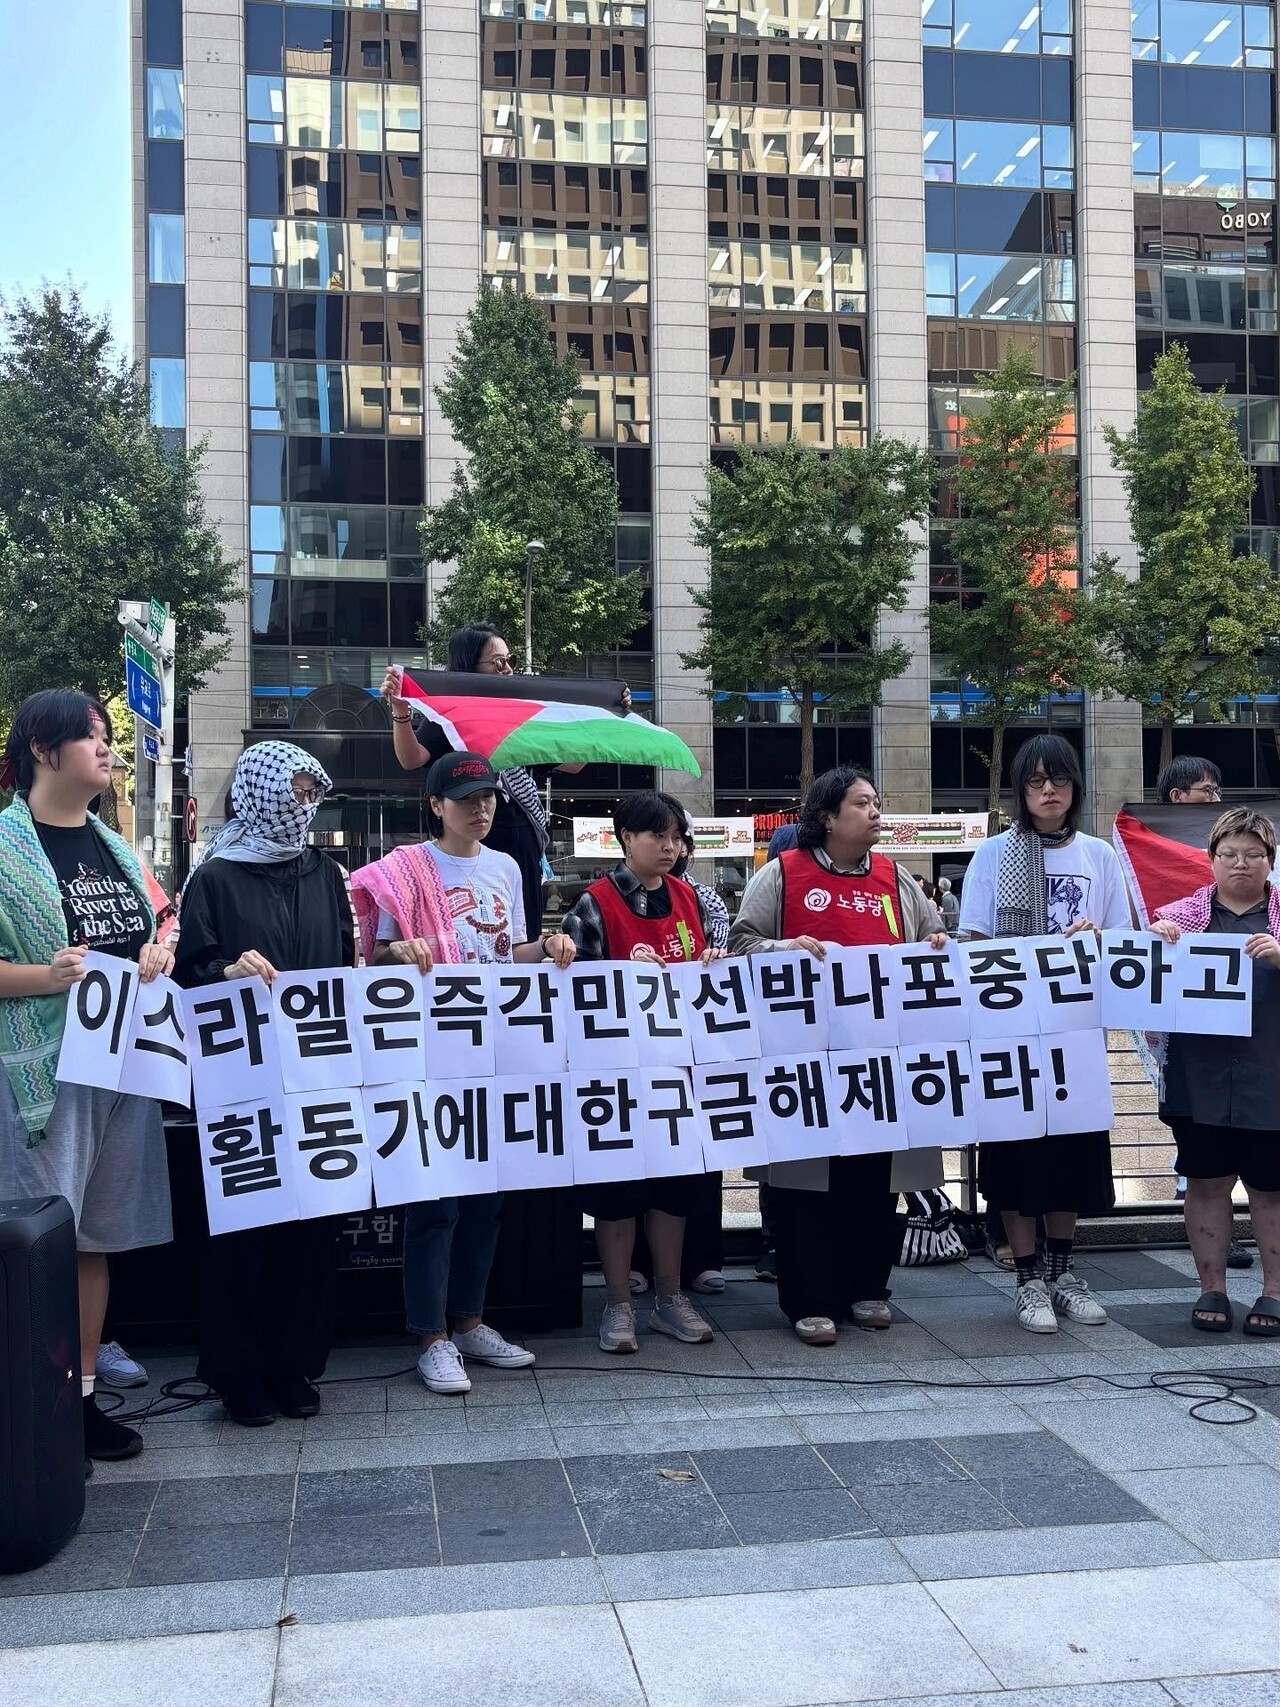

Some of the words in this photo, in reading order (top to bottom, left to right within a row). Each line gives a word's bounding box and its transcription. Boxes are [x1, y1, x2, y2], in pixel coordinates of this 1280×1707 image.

[101, 875, 129, 893] the
[65, 896, 120, 916] River
[119, 893, 139, 912] to
[836, 893, 885, 917] 노동당
[81, 915, 114, 938] the
[112, 912, 146, 933] Sea
[342, 1213, 399, 1246] 구함
